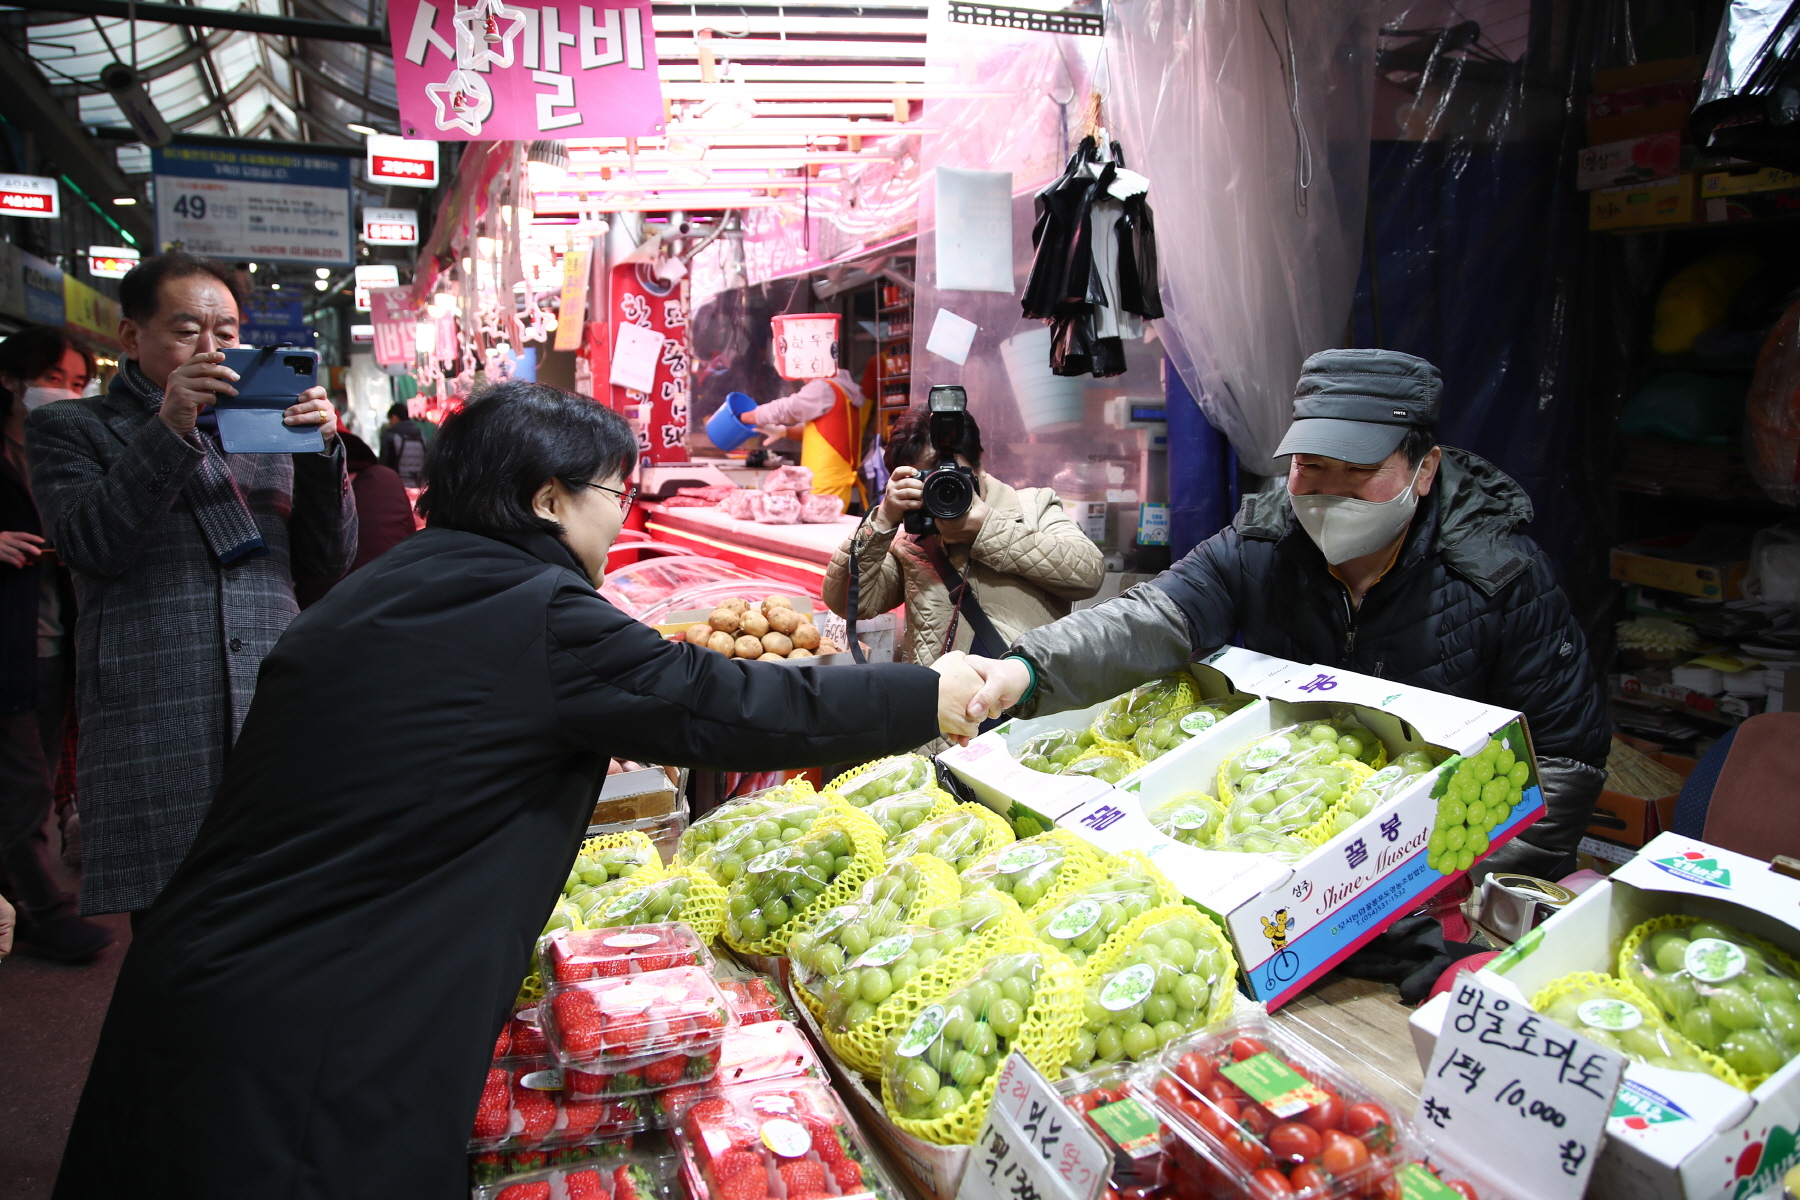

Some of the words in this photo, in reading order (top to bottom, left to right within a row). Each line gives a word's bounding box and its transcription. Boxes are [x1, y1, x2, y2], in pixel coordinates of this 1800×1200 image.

[405, 0, 645, 131] 생갈비
[173, 194, 206, 219] 49
[1292, 878, 1312, 898] 상주
[1316, 876, 1364, 916] Shine
[1365, 826, 1430, 882] Muscat
[1455, 984, 1607, 1100] 방울토마토
[1438, 1047, 1487, 1094] 1팩
[1494, 1079, 1567, 1128] 10,000
[1023, 1100, 1062, 1159] 먹는
[1559, 1139, 1587, 1176] 원
